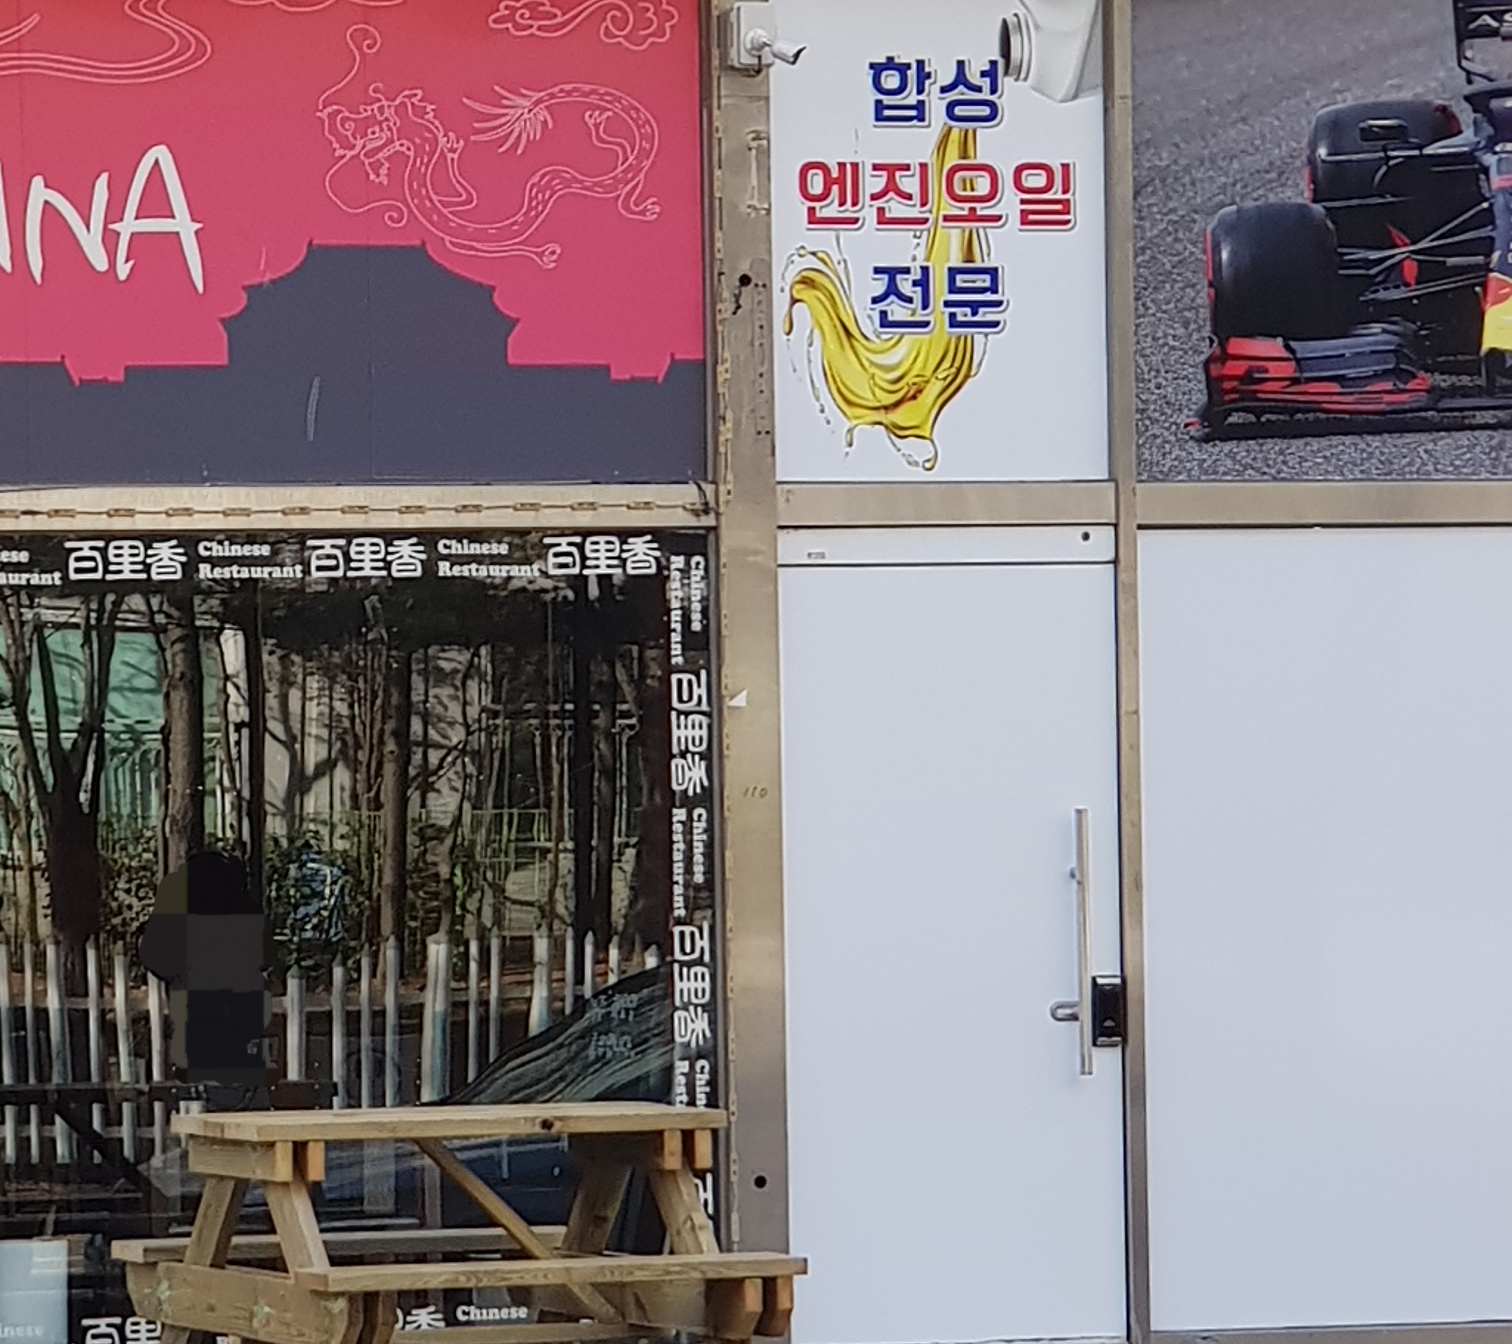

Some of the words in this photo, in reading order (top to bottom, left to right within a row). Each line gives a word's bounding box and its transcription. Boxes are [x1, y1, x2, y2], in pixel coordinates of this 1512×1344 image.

[868, 56, 1004, 126] 합성
[797, 160, 1077, 231] 엔진오일
[868, 264, 1008, 334] 전문
[64, 539, 188, 582] 百里香
[198, 541, 271, 557] Chinese
[198, 562, 304, 579] Restaurant
[305, 537, 427, 578] 百里香
[437, 540, 509, 555] Chinese
[437, 560, 541, 578] Restaurant
[543, 534, 662, 576] 百里香
[669, 555, 685, 665] Restaurant
[690, 555, 703, 633] Chinese
[670, 668, 710, 797] 百里香
[671, 808, 687, 918] Restaurant
[691, 806, 706, 884] Chinese
[672, 920, 712, 1048] 百里香
[695, 1059, 710, 1109] Chin
[455, 1304, 529, 1321] Chinese
